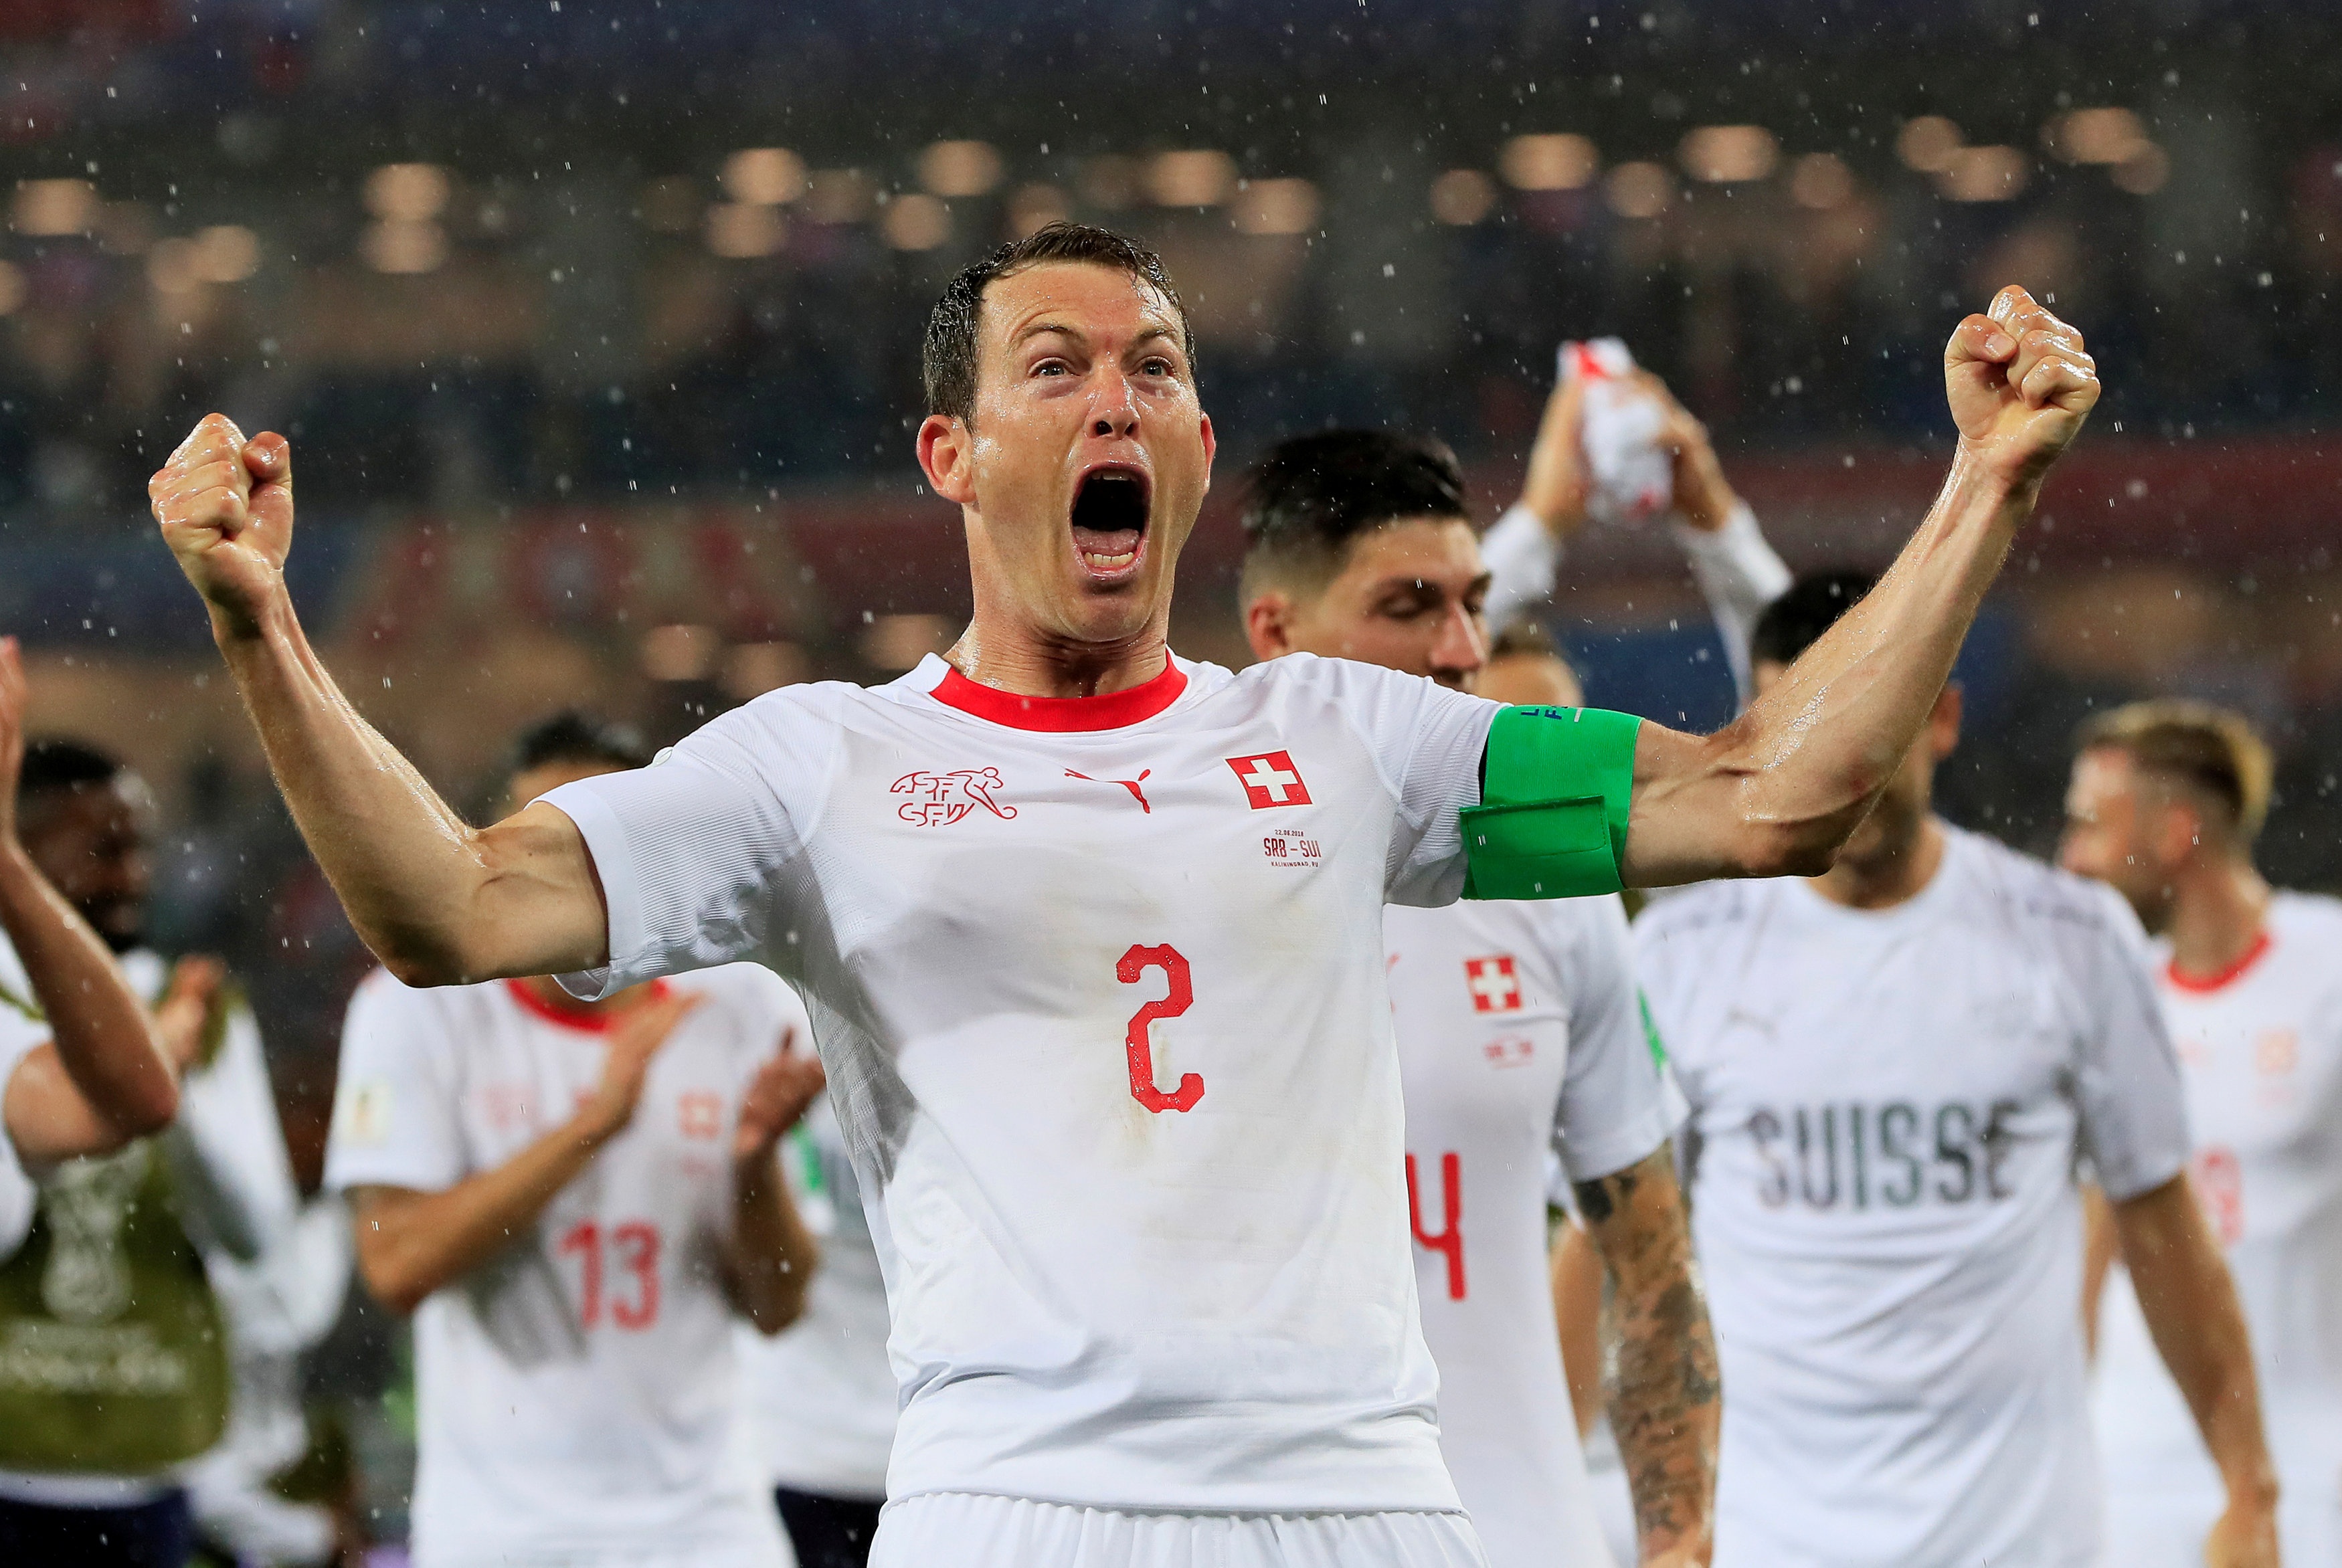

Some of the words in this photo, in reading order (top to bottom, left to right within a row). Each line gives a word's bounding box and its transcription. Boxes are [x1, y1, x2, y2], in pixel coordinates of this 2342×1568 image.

[1263, 838, 1287, 858] SRB
[1299, 841, 1322, 858] SUI
[1115, 943, 1205, 1114] 2
[1747, 1097, 2023, 1211] SUISSE
[557, 1220, 661, 1331] 13
